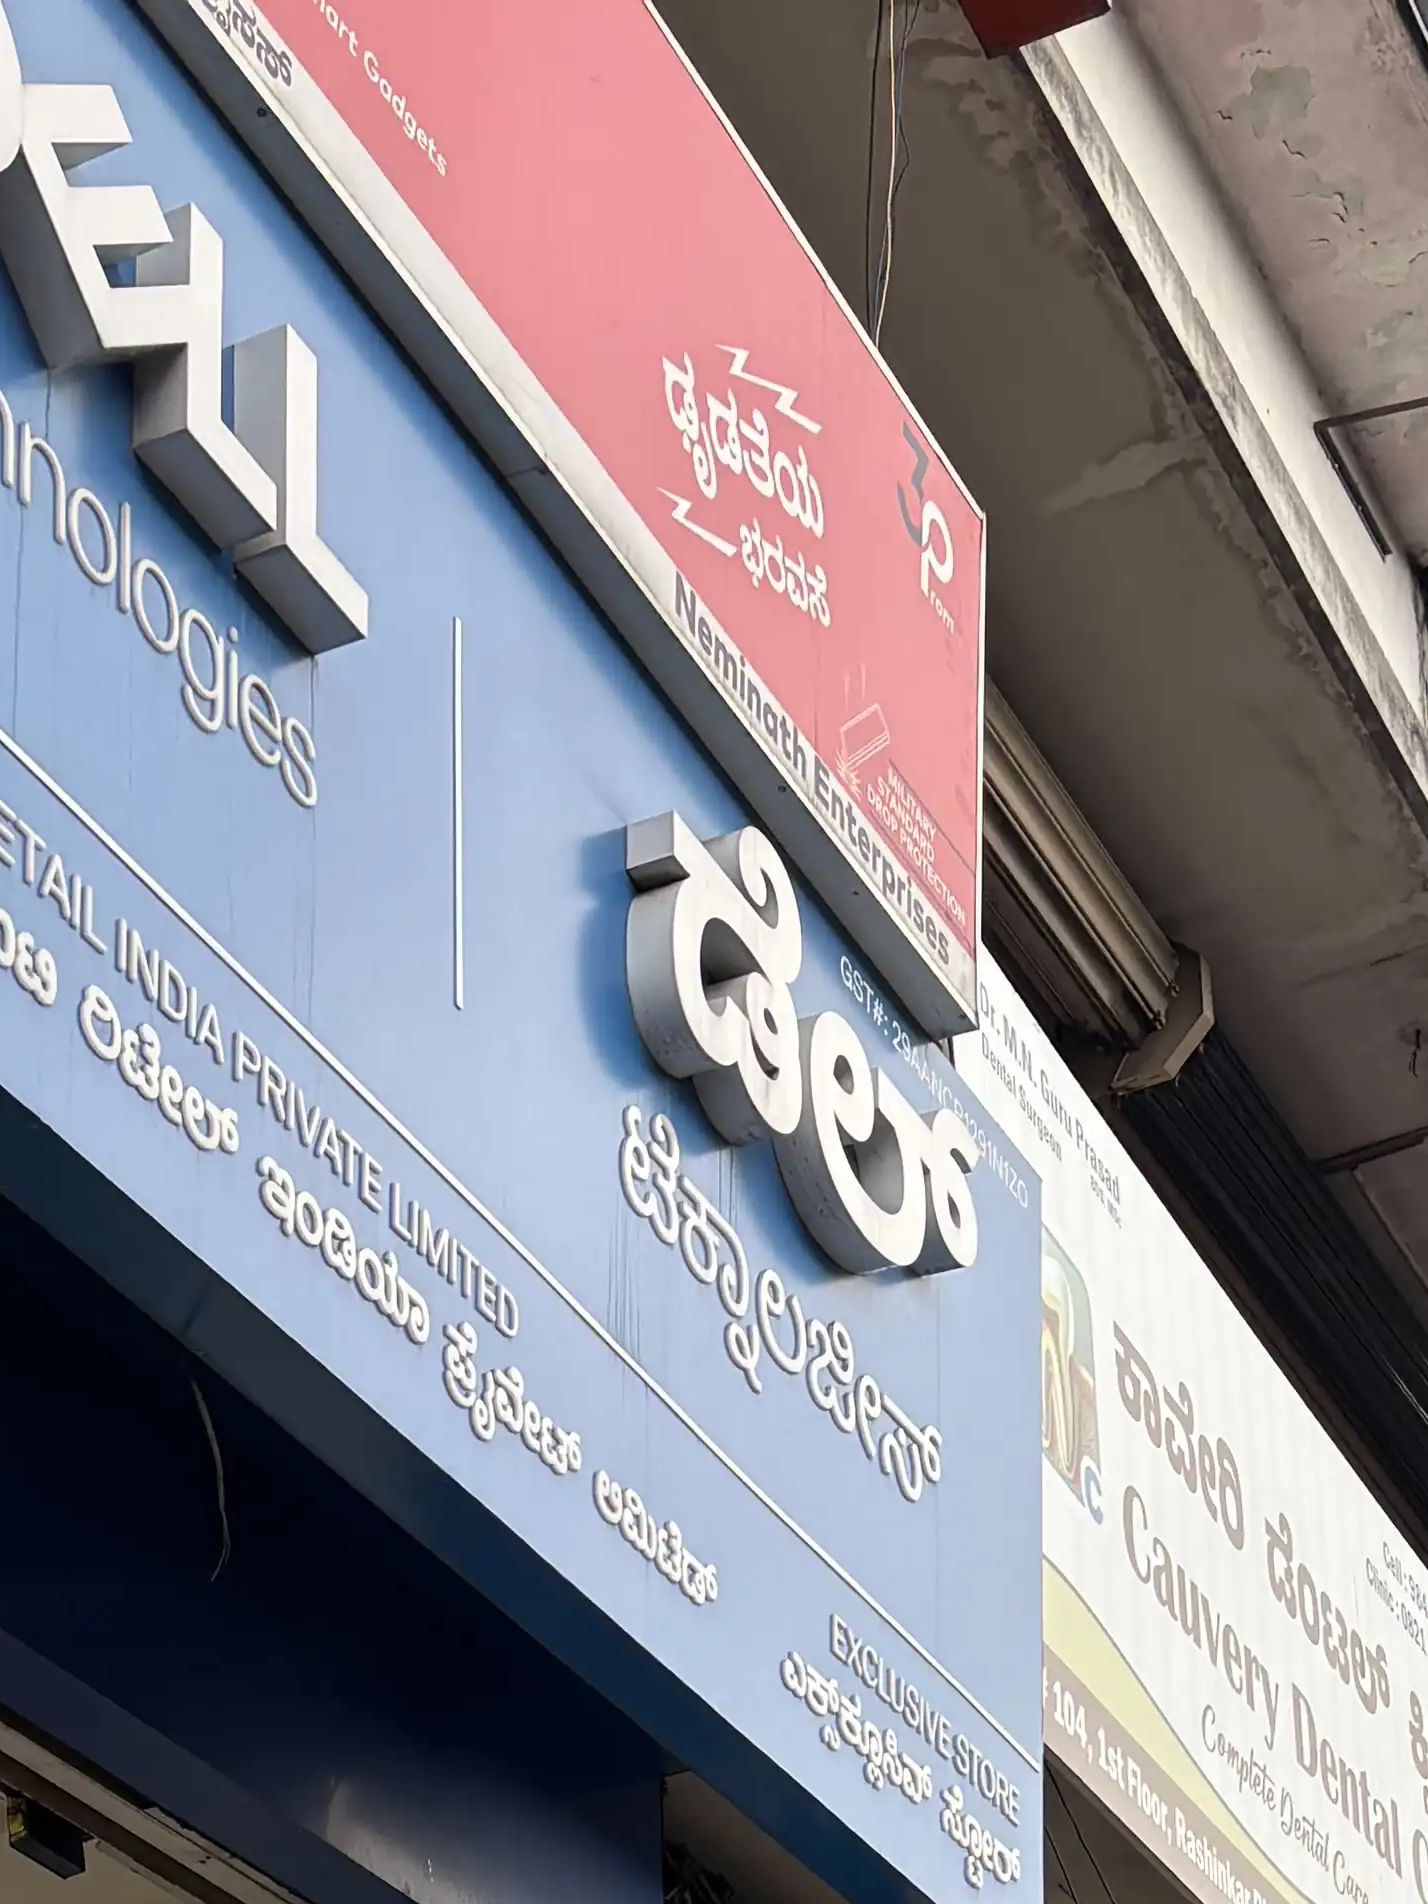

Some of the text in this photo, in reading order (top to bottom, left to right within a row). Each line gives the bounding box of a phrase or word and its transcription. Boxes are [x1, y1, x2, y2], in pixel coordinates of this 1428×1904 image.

[363, 49, 448, 177] Gadgets
[673, 571, 952, 967] Neminath Enterprises
[876, 777, 935, 863] STANDARD
[887, 766, 937, 842] MILITARY
[867, 784, 966, 927] DROP PROTECTION
[114, 918, 226, 1064] INDIA
[233, 1030, 383, 1214] PRIVATE
[389, 1182, 520, 1339] LIMITED
[980, 1031, 1063, 1163] Dental Surgeon
[1038, 1066, 1074, 1142] Guru
[1075, 1118, 1121, 1206] Prasad
[830, 1613, 1021, 1826] EXCLUSIVE STORE
[1053, 1682, 1095, 1750] 104,
[1098, 1743, 1125, 1792] 1st
[1125, 1758, 1172, 1840] Floor,
[1122, 1495, 1281, 1750] Cauvery
[1291, 1682, 1403, 1879] Dental
[1201, 1703, 1277, 1807] Complete
[1280, 1790, 1329, 1865] Dental
